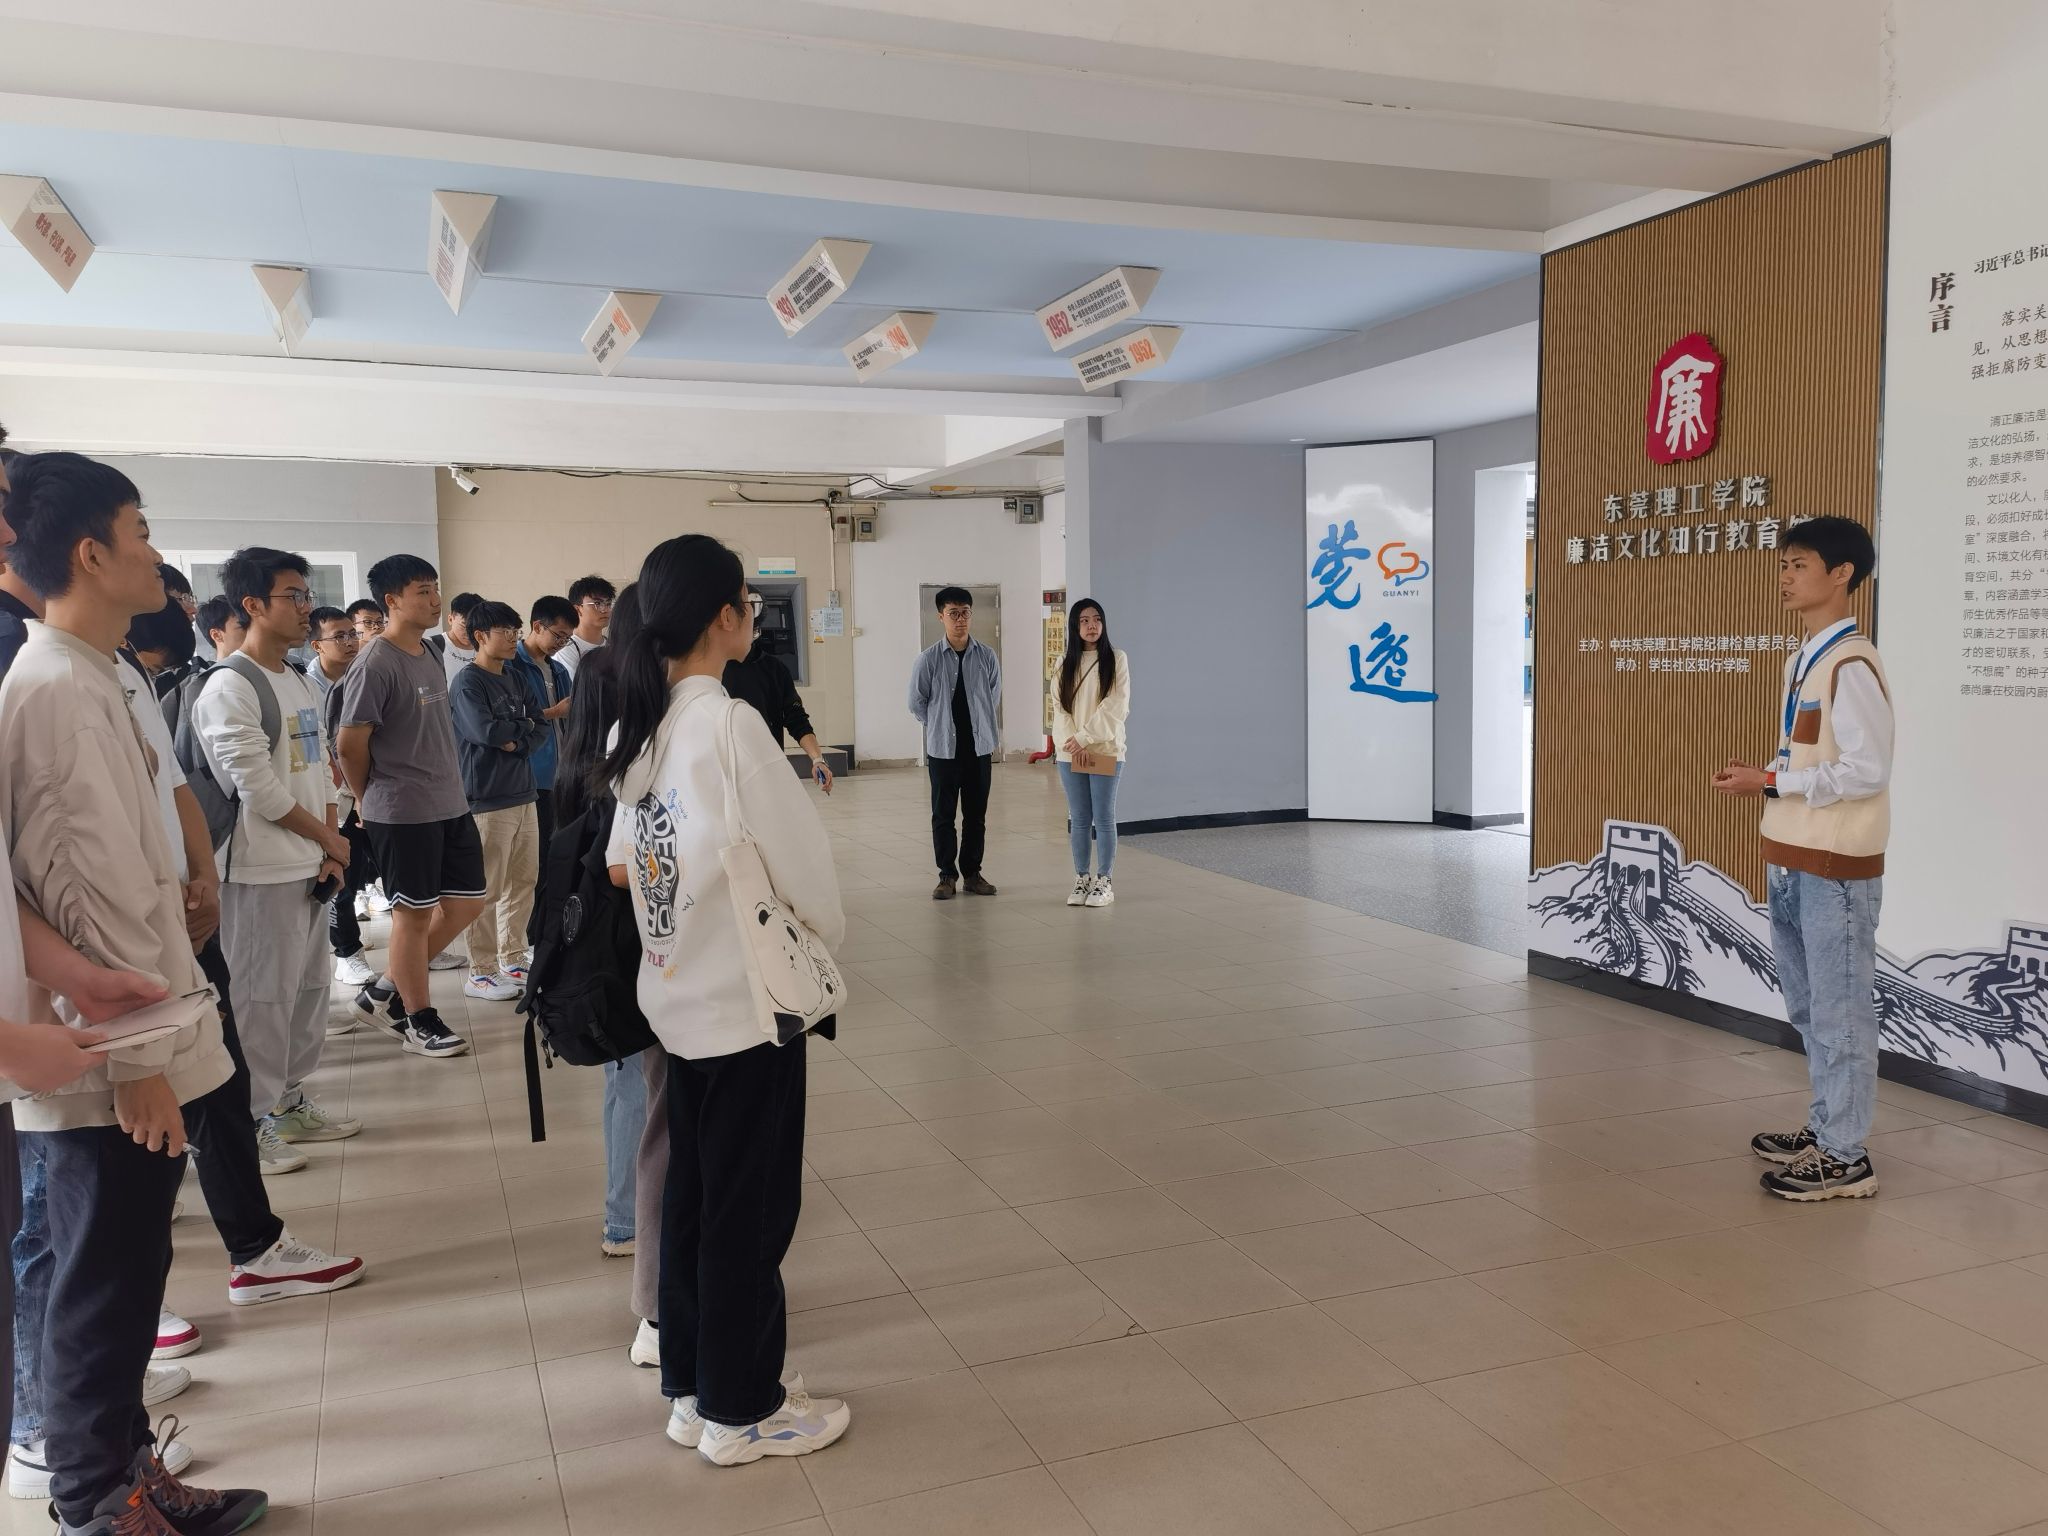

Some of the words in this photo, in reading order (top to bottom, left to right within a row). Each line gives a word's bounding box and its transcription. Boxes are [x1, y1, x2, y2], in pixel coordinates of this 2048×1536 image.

[1974, 244, 2048, 273] 习近平总书记
[1928, 272, 1956, 333] 序言
[2001, 303, 2048, 327] 落实关
[1046, 310, 1073, 340] 1952
[1128, 338, 1156, 364] 1952
[1971, 329, 2048, 357] 见，从思想
[1971, 352, 2048, 380] 强拒腐防变
[1967, 448, 2048, 469] 求，是培养德智
[1966, 471, 2027, 487] 的必然要求。
[1603, 475, 1768, 523] 东莞理工学院
[1964, 568, 2048, 583] 育空间，共分“
[1382, 589, 1419, 597] GUANYI
[1615, 657, 1750, 673] 承办：学生社区知行学院
